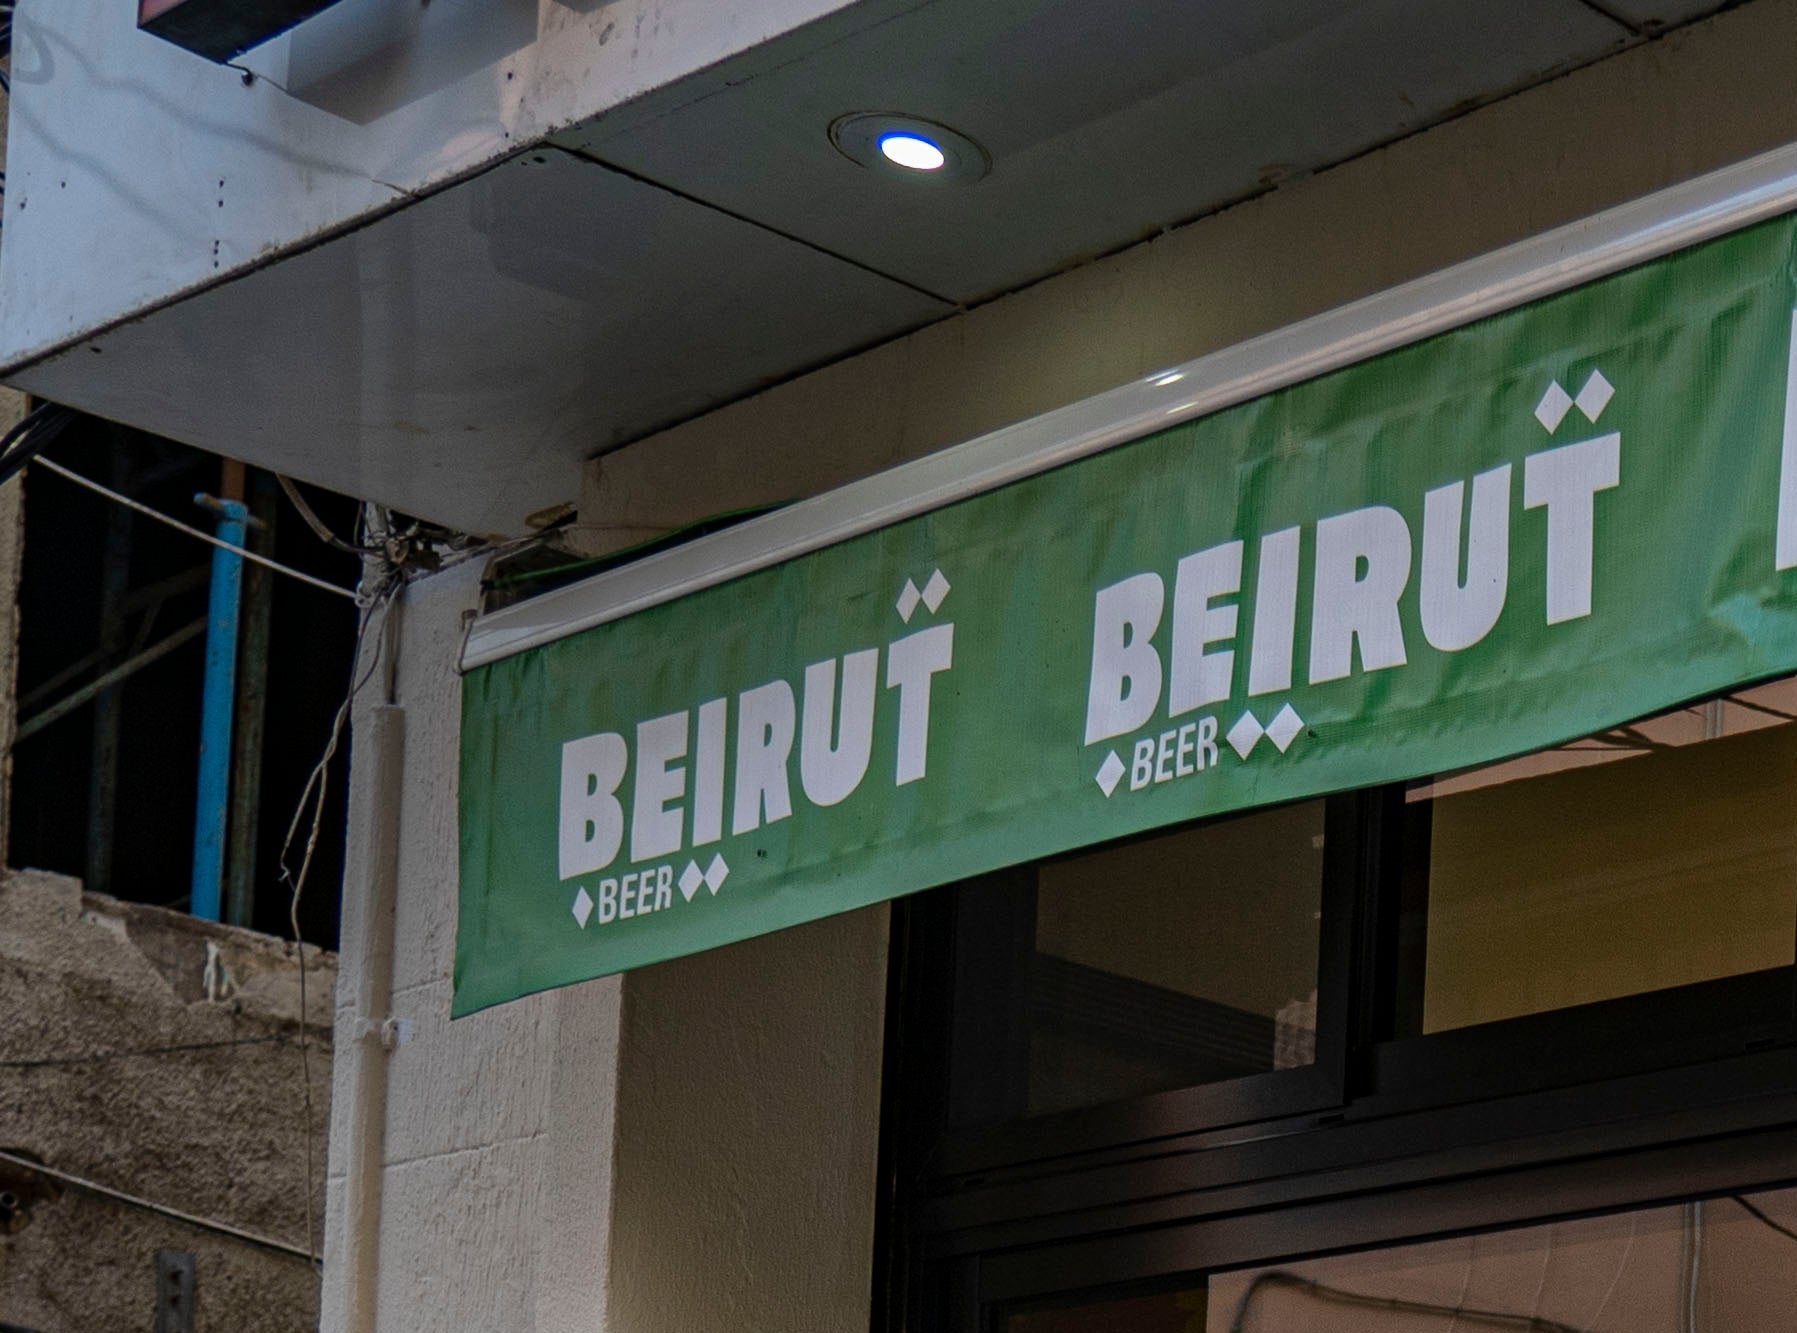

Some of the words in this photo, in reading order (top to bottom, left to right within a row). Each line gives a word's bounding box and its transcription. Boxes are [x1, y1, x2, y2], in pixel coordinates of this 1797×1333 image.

[1084, 431, 1621, 747] BEIRUT
[558, 621, 955, 881] BEIRUT
[1130, 716, 1219, 791] BEER
[598, 866, 673, 925] BEER
